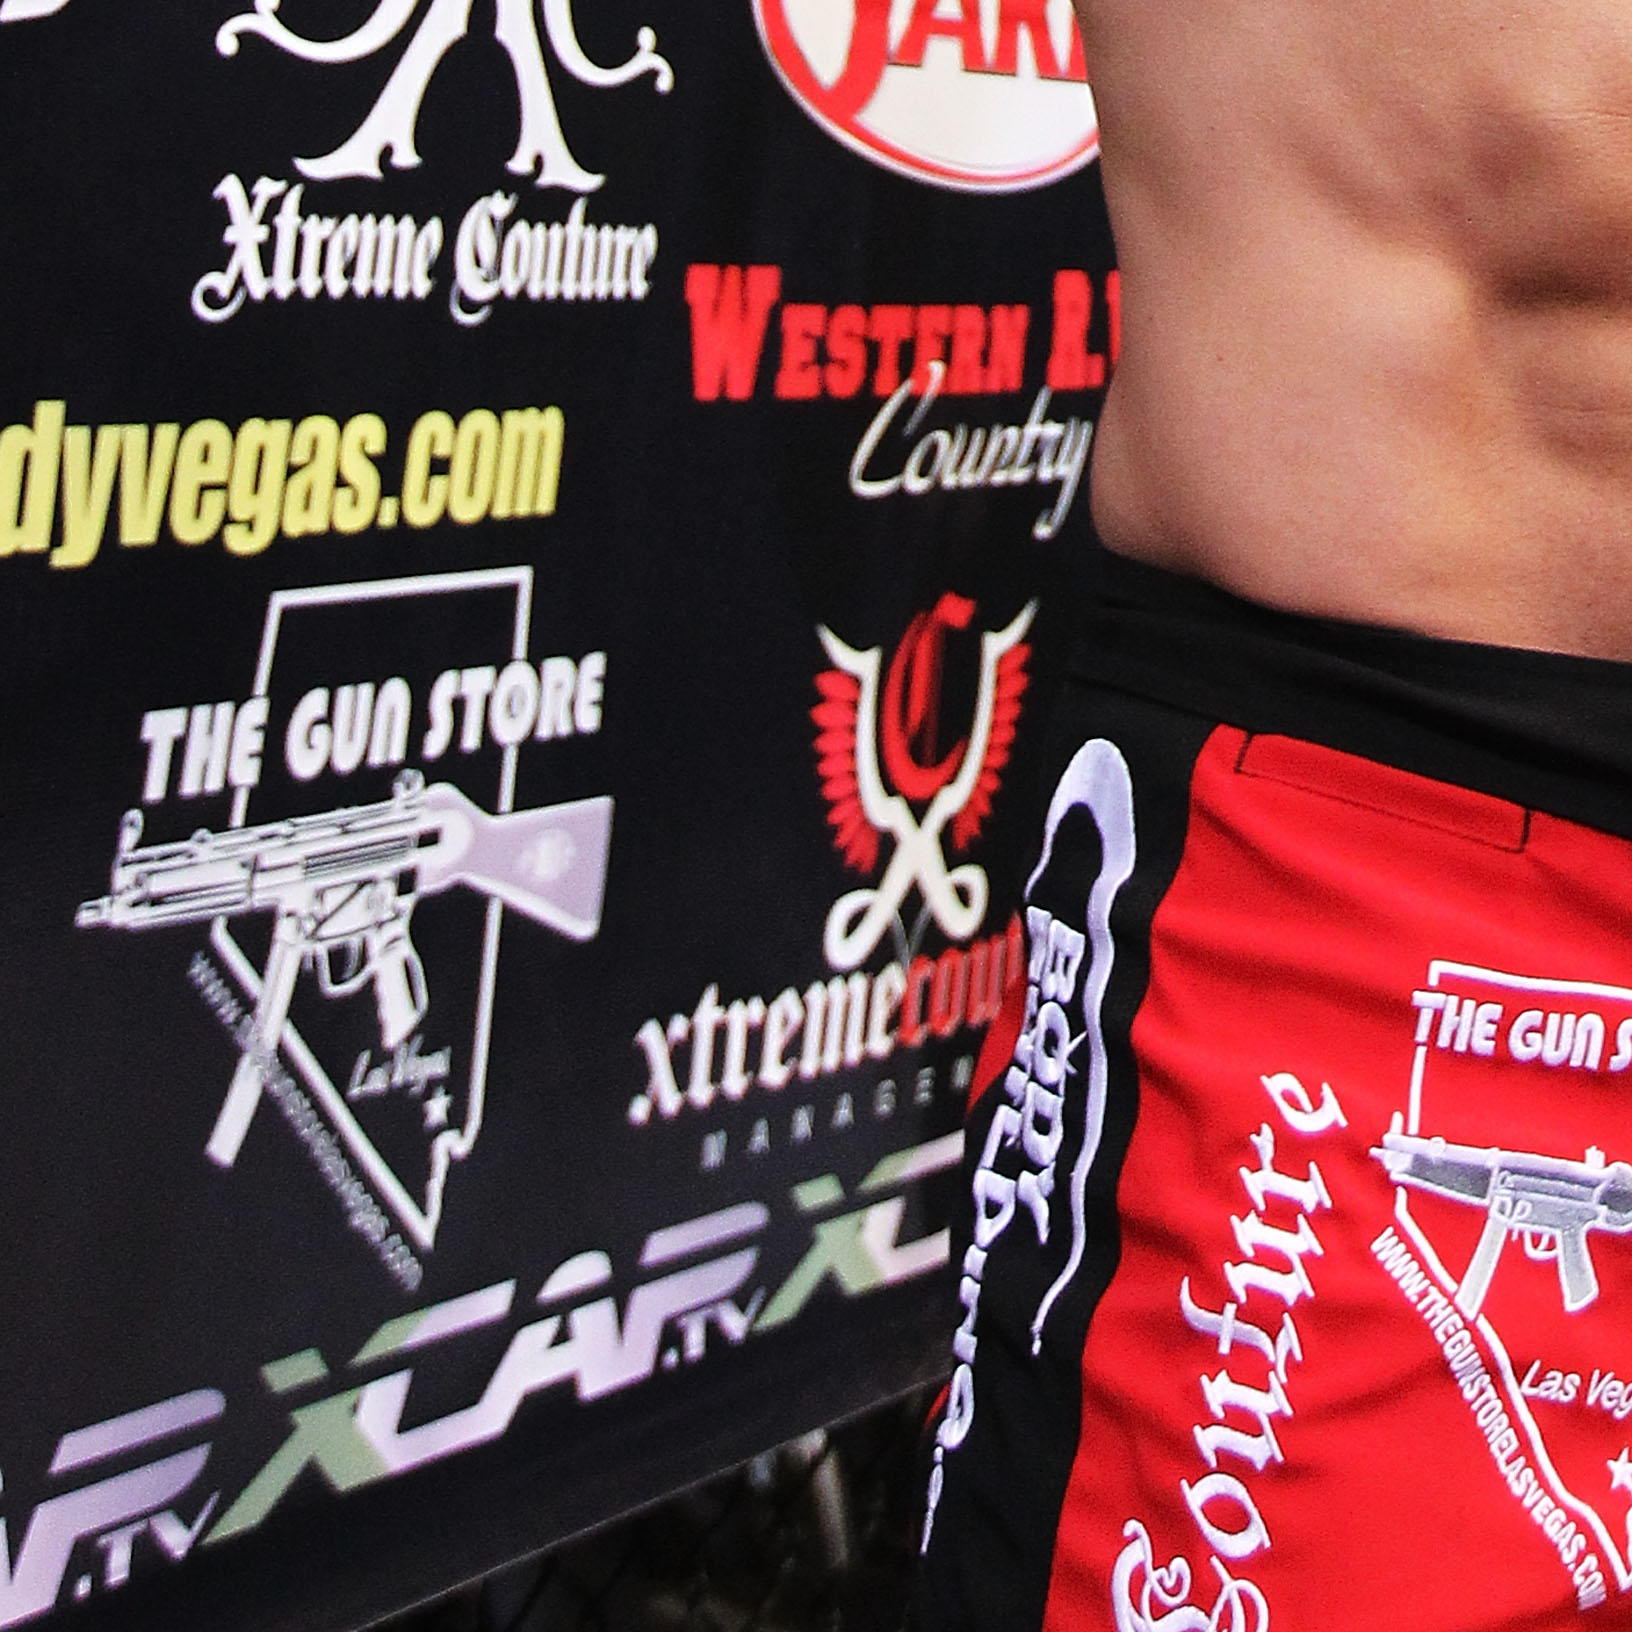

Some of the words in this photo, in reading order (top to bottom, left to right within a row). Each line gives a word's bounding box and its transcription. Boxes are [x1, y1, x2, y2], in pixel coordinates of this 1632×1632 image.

[191, 173, 443, 323] Xtreme
[449, 190, 658, 327] Couture
[0, 399, 566, 570] dyvegas.com
[848, 359, 1094, 540] Country
[139, 695, 270, 804] THE
[285, 676, 412, 781] GUN
[422, 651, 607, 761] STORE
[1017, 918, 1086, 1246] BODY
[1411, 989, 1504, 1058] THE
[1507, 1007, 1606, 1072] GUN
[1519, 1359, 1582, 1404] Las
